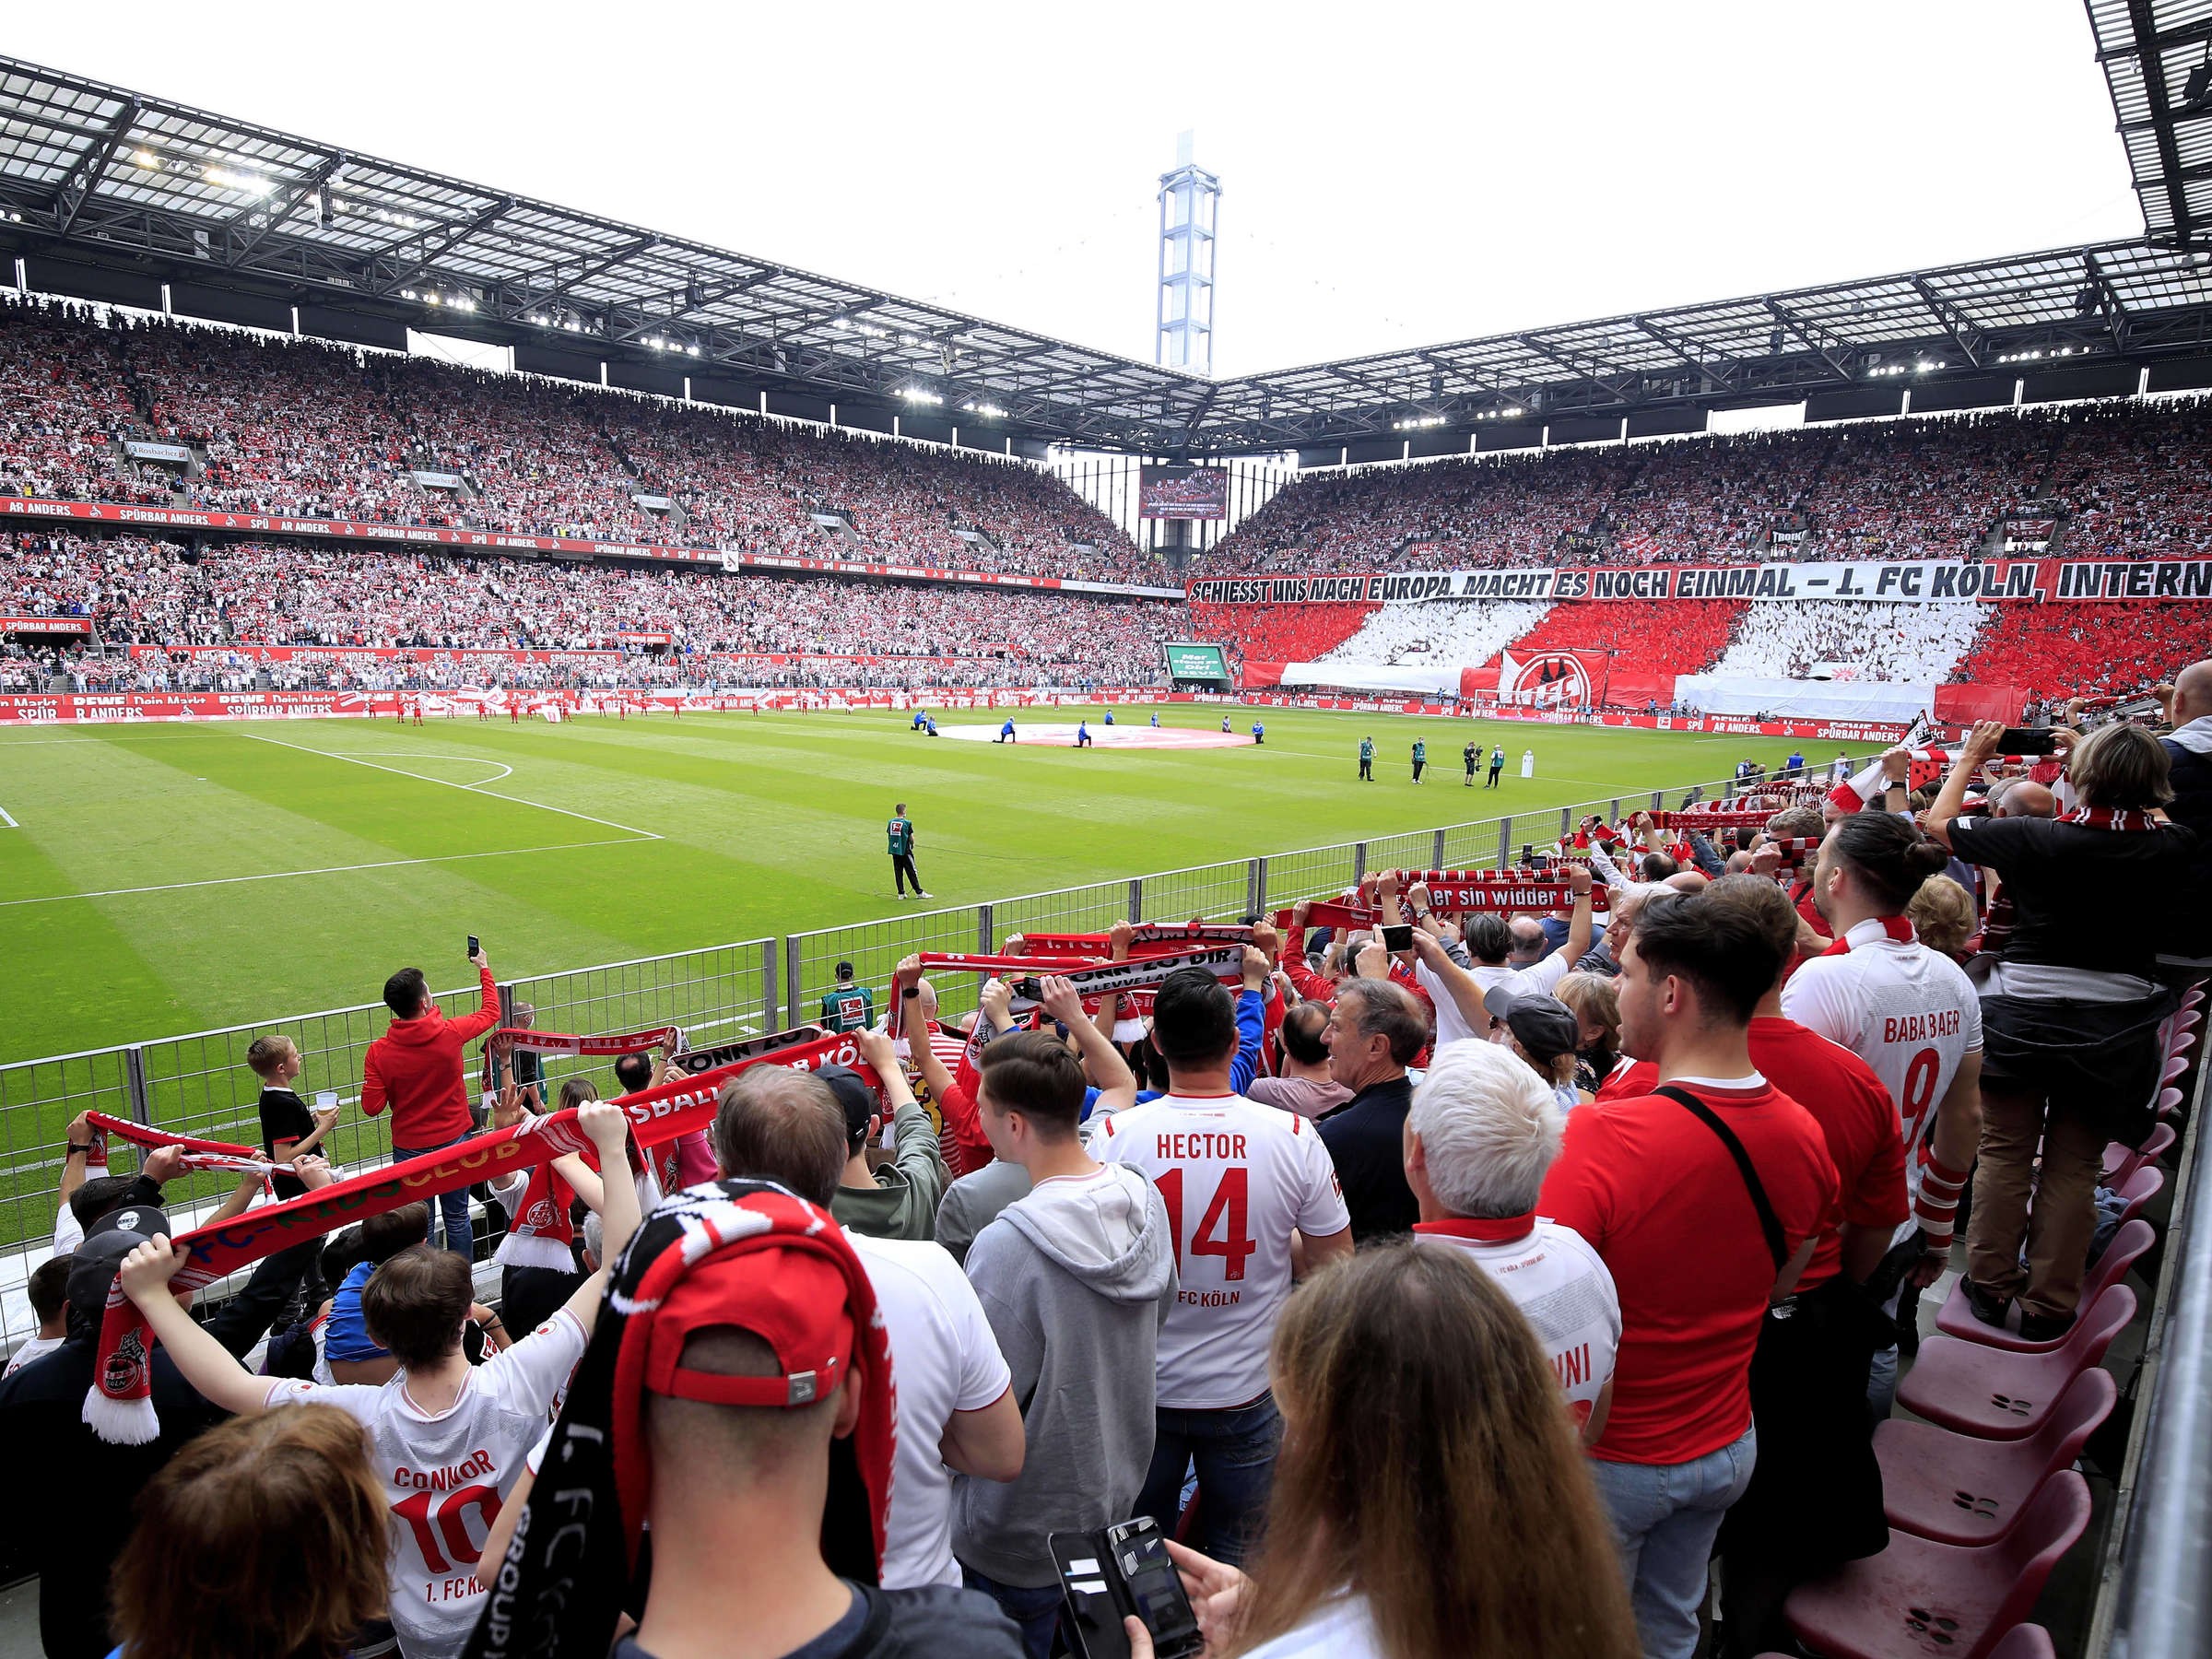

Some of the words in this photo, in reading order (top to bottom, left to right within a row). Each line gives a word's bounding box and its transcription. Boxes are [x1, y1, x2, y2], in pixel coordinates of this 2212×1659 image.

[138, 446, 178, 457] Rosbacher
[28, 502, 75, 517] ANDERS.
[120, 508, 168, 524] SPÜRBAR
[170, 512, 211, 526] ANDERS.
[250, 515, 269, 529] SPÜ
[280, 521, 293, 532] AR
[295, 522, 333, 535] ANDERS.
[367, 525, 406, 539] SPÜRBAR
[406, 529, 441, 542] ANDERS.
[471, 534, 488, 545] SPÜ
[508, 536, 538, 548] ANDERS.
[594, 542, 626, 555] SPÜRBAR
[627, 546, 653, 558] ANDERS.
[753, 555, 779, 566] SPÜRBAR
[1191, 580, 1271, 604] SCHIESST
[1272, 578, 1308, 603] UNS
[1310, 577, 1365, 601] NACH
[1368, 575, 1454, 601] EUROPA.
[1462, 573, 1551, 596] MACHT
[1555, 570, 1588, 596] ES
[1594, 570, 1669, 598] NOCH
[1676, 567, 1797, 597] EINMAL
[1835, 568, 1865, 595] 1.
[1876, 566, 1923, 595] FC
[1931, 558, 2044, 605] KÖLN,
[6, 620, 46, 632] SPÜRBAR
[49, 622, 85, 633] ANDERS.
[1194, 693, 1221, 702] SPÜRBAR
[18, 704, 57, 720] SPÜR
[89, 706, 143, 719] ANDERS
[227, 701, 285, 716] SPÜRBAR
[288, 704, 333, 715] ANDERS
[1352, 700, 1379, 712] SPÜRBAR
[1380, 703, 1405, 713] ANDERS.
[1727, 723, 1763, 735] ANDERS.
[1817, 726, 1862, 741] SPÜRBAR
[1459, 887, 1487, 906] sin
[1493, 886, 1558, 906] widder
[1883, 1015, 1926, 1044] BABA
[1927, 1008, 1960, 1039] BAER
[1901, 1047, 1940, 1159] 9
[1157, 1133, 1247, 1159] HECTOR
[1152, 1167, 1257, 1281] 14
[1178, 1289, 1198, 1306] FC
[1200, 1288, 1241, 1308] KÖLN
[389, 1483, 503, 1575] 10
[487, 1504, 533, 1646] GROUP
[425, 1583, 437, 1603] 1.
[443, 1577, 465, 1601] FC
